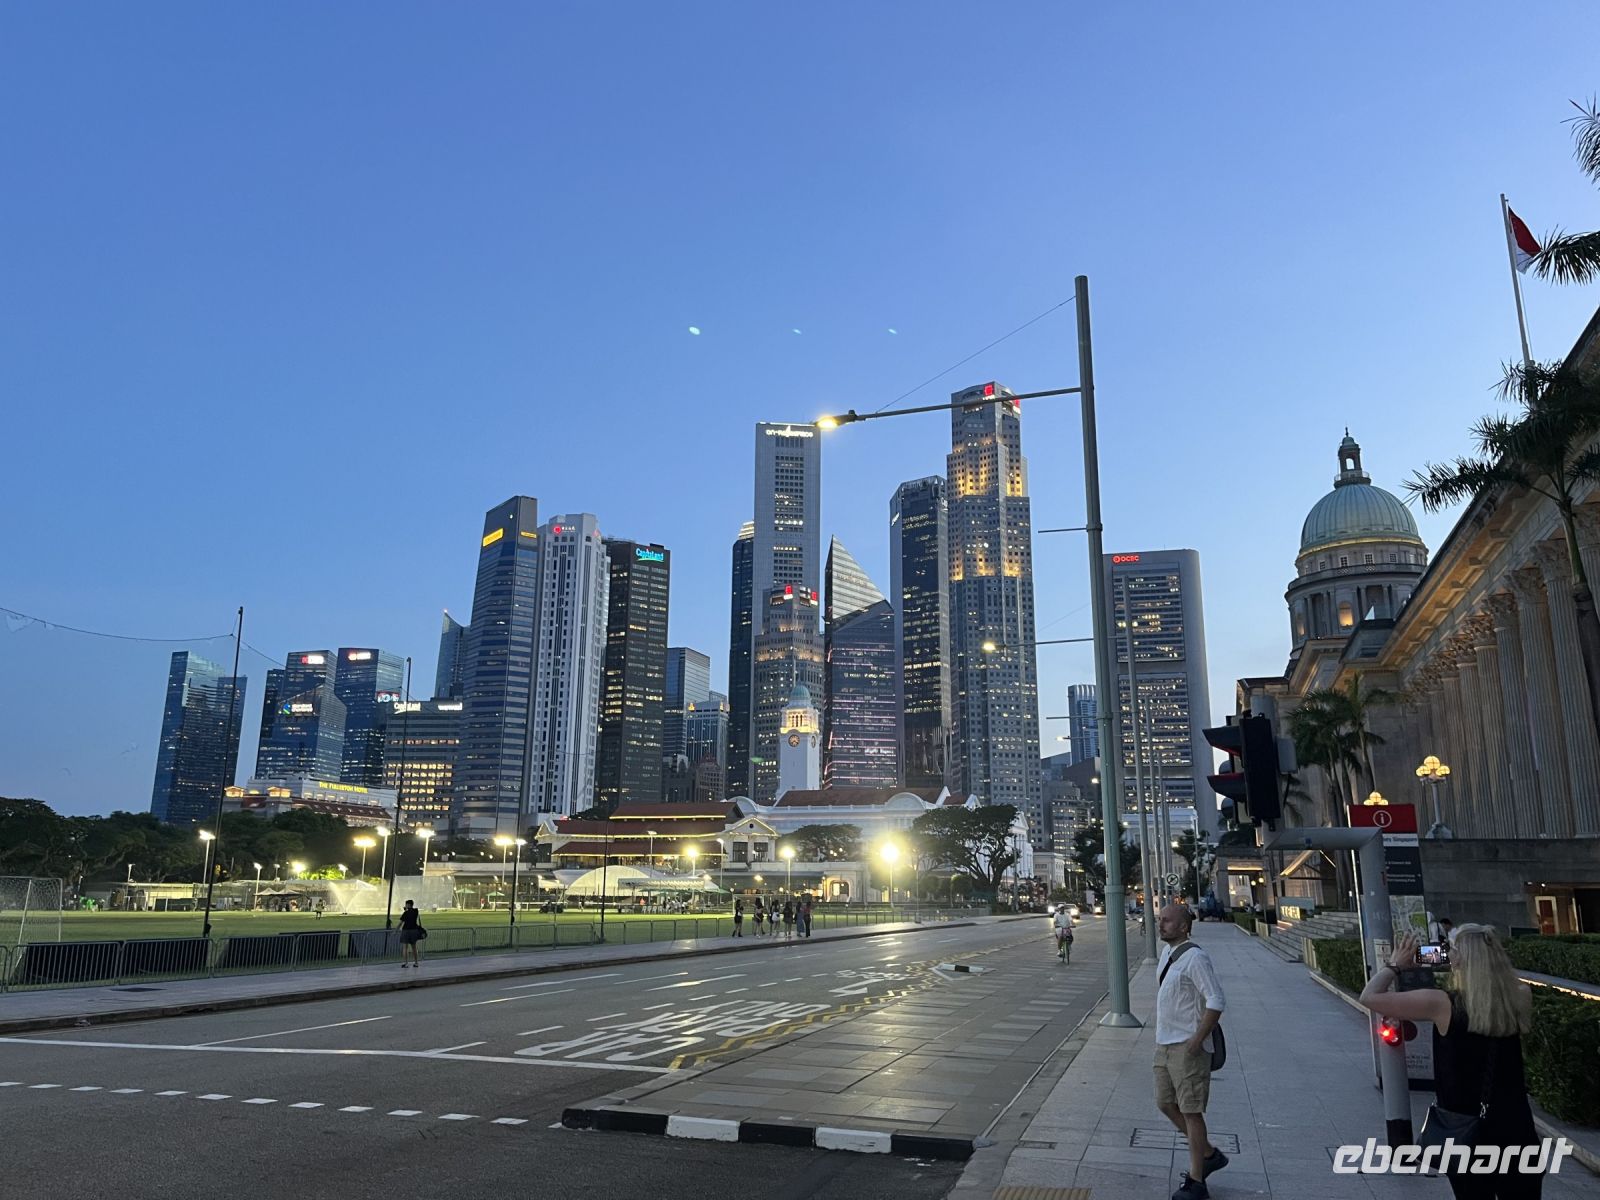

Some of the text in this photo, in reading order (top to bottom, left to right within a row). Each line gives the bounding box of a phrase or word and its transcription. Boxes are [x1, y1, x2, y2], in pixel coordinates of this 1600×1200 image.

[680, 1000, 832, 1018] ONLY
[594, 1012, 791, 1038] PARK
[514, 1031, 706, 1062] CAR
